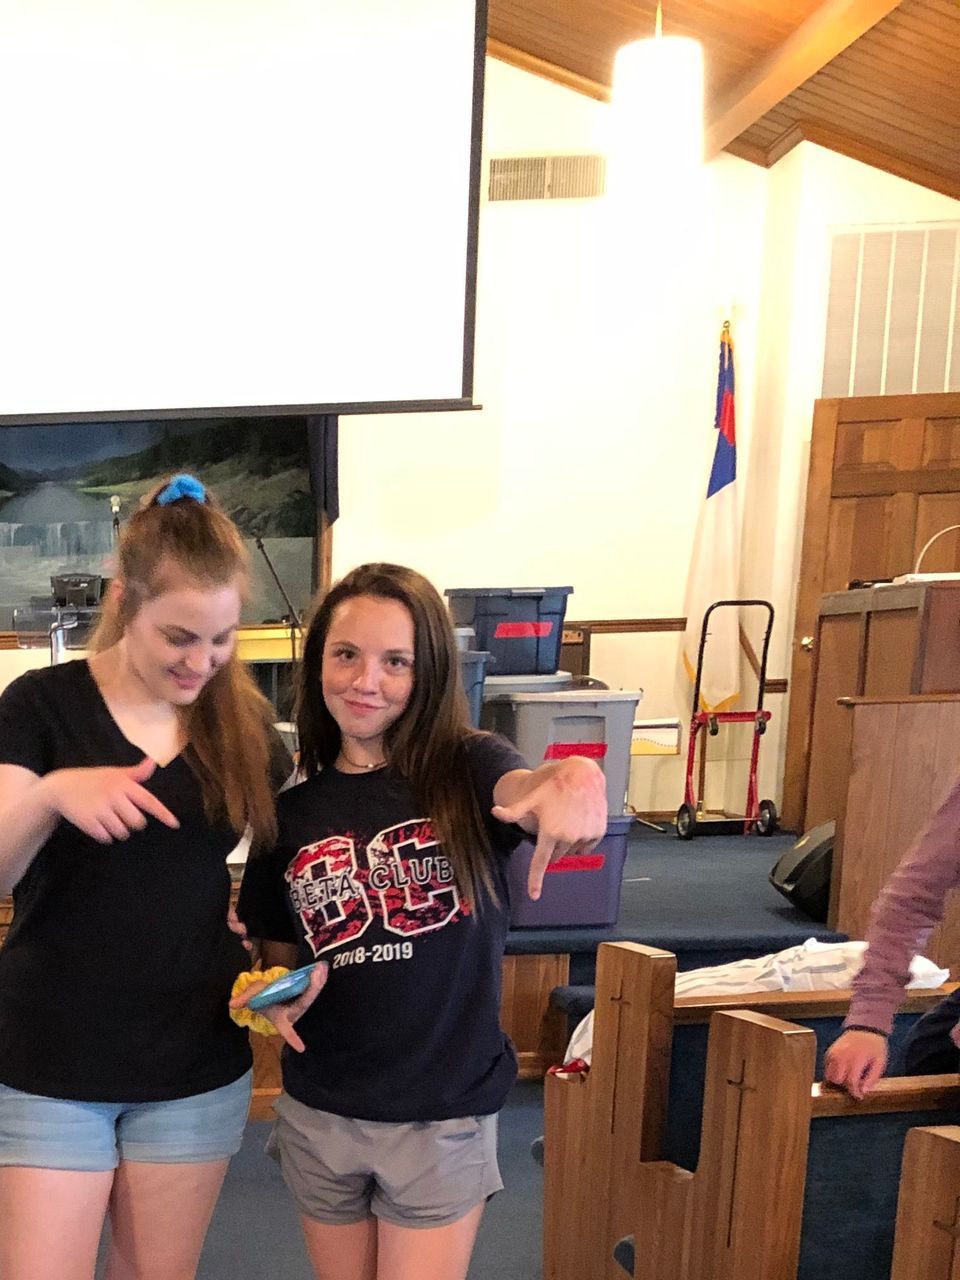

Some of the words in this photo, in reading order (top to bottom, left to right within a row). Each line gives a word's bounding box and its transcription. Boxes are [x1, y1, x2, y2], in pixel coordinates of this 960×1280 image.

[289, 867, 362, 914] BETA
[369, 855, 455, 892] CLUB
[332, 941, 414, 970] 2018-2019
